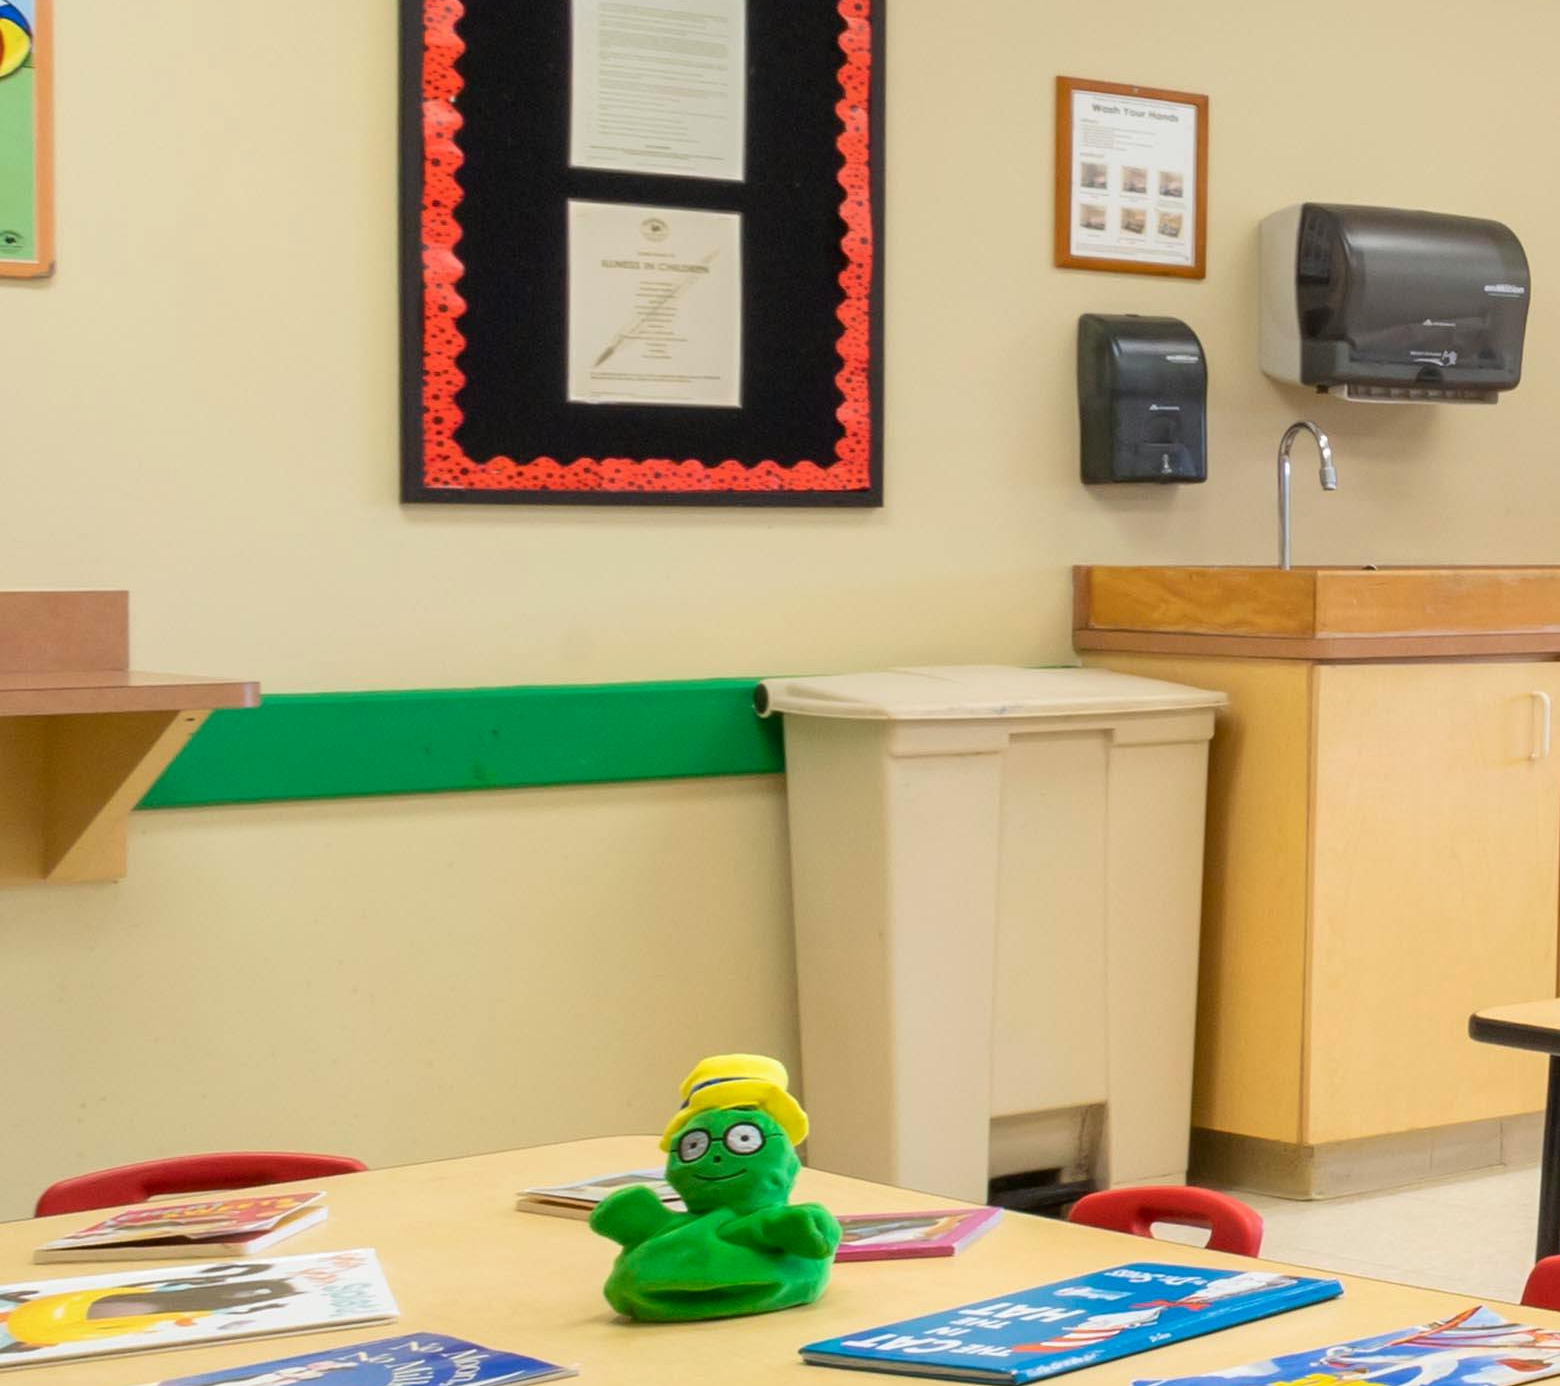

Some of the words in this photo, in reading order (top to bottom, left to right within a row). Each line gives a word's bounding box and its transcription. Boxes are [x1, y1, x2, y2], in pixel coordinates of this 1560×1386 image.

[957, 1302, 1075, 1323] HAT
[950, 1317, 1002, 1329] THE
[922, 1326, 966, 1336] IN
[841, 1333, 967, 1356] CAT
[967, 1344, 1014, 1357] THE
[337, 1351, 395, 1364] No
[390, 1340, 444, 1353] No
[440, 1348, 490, 1386] Moon,
